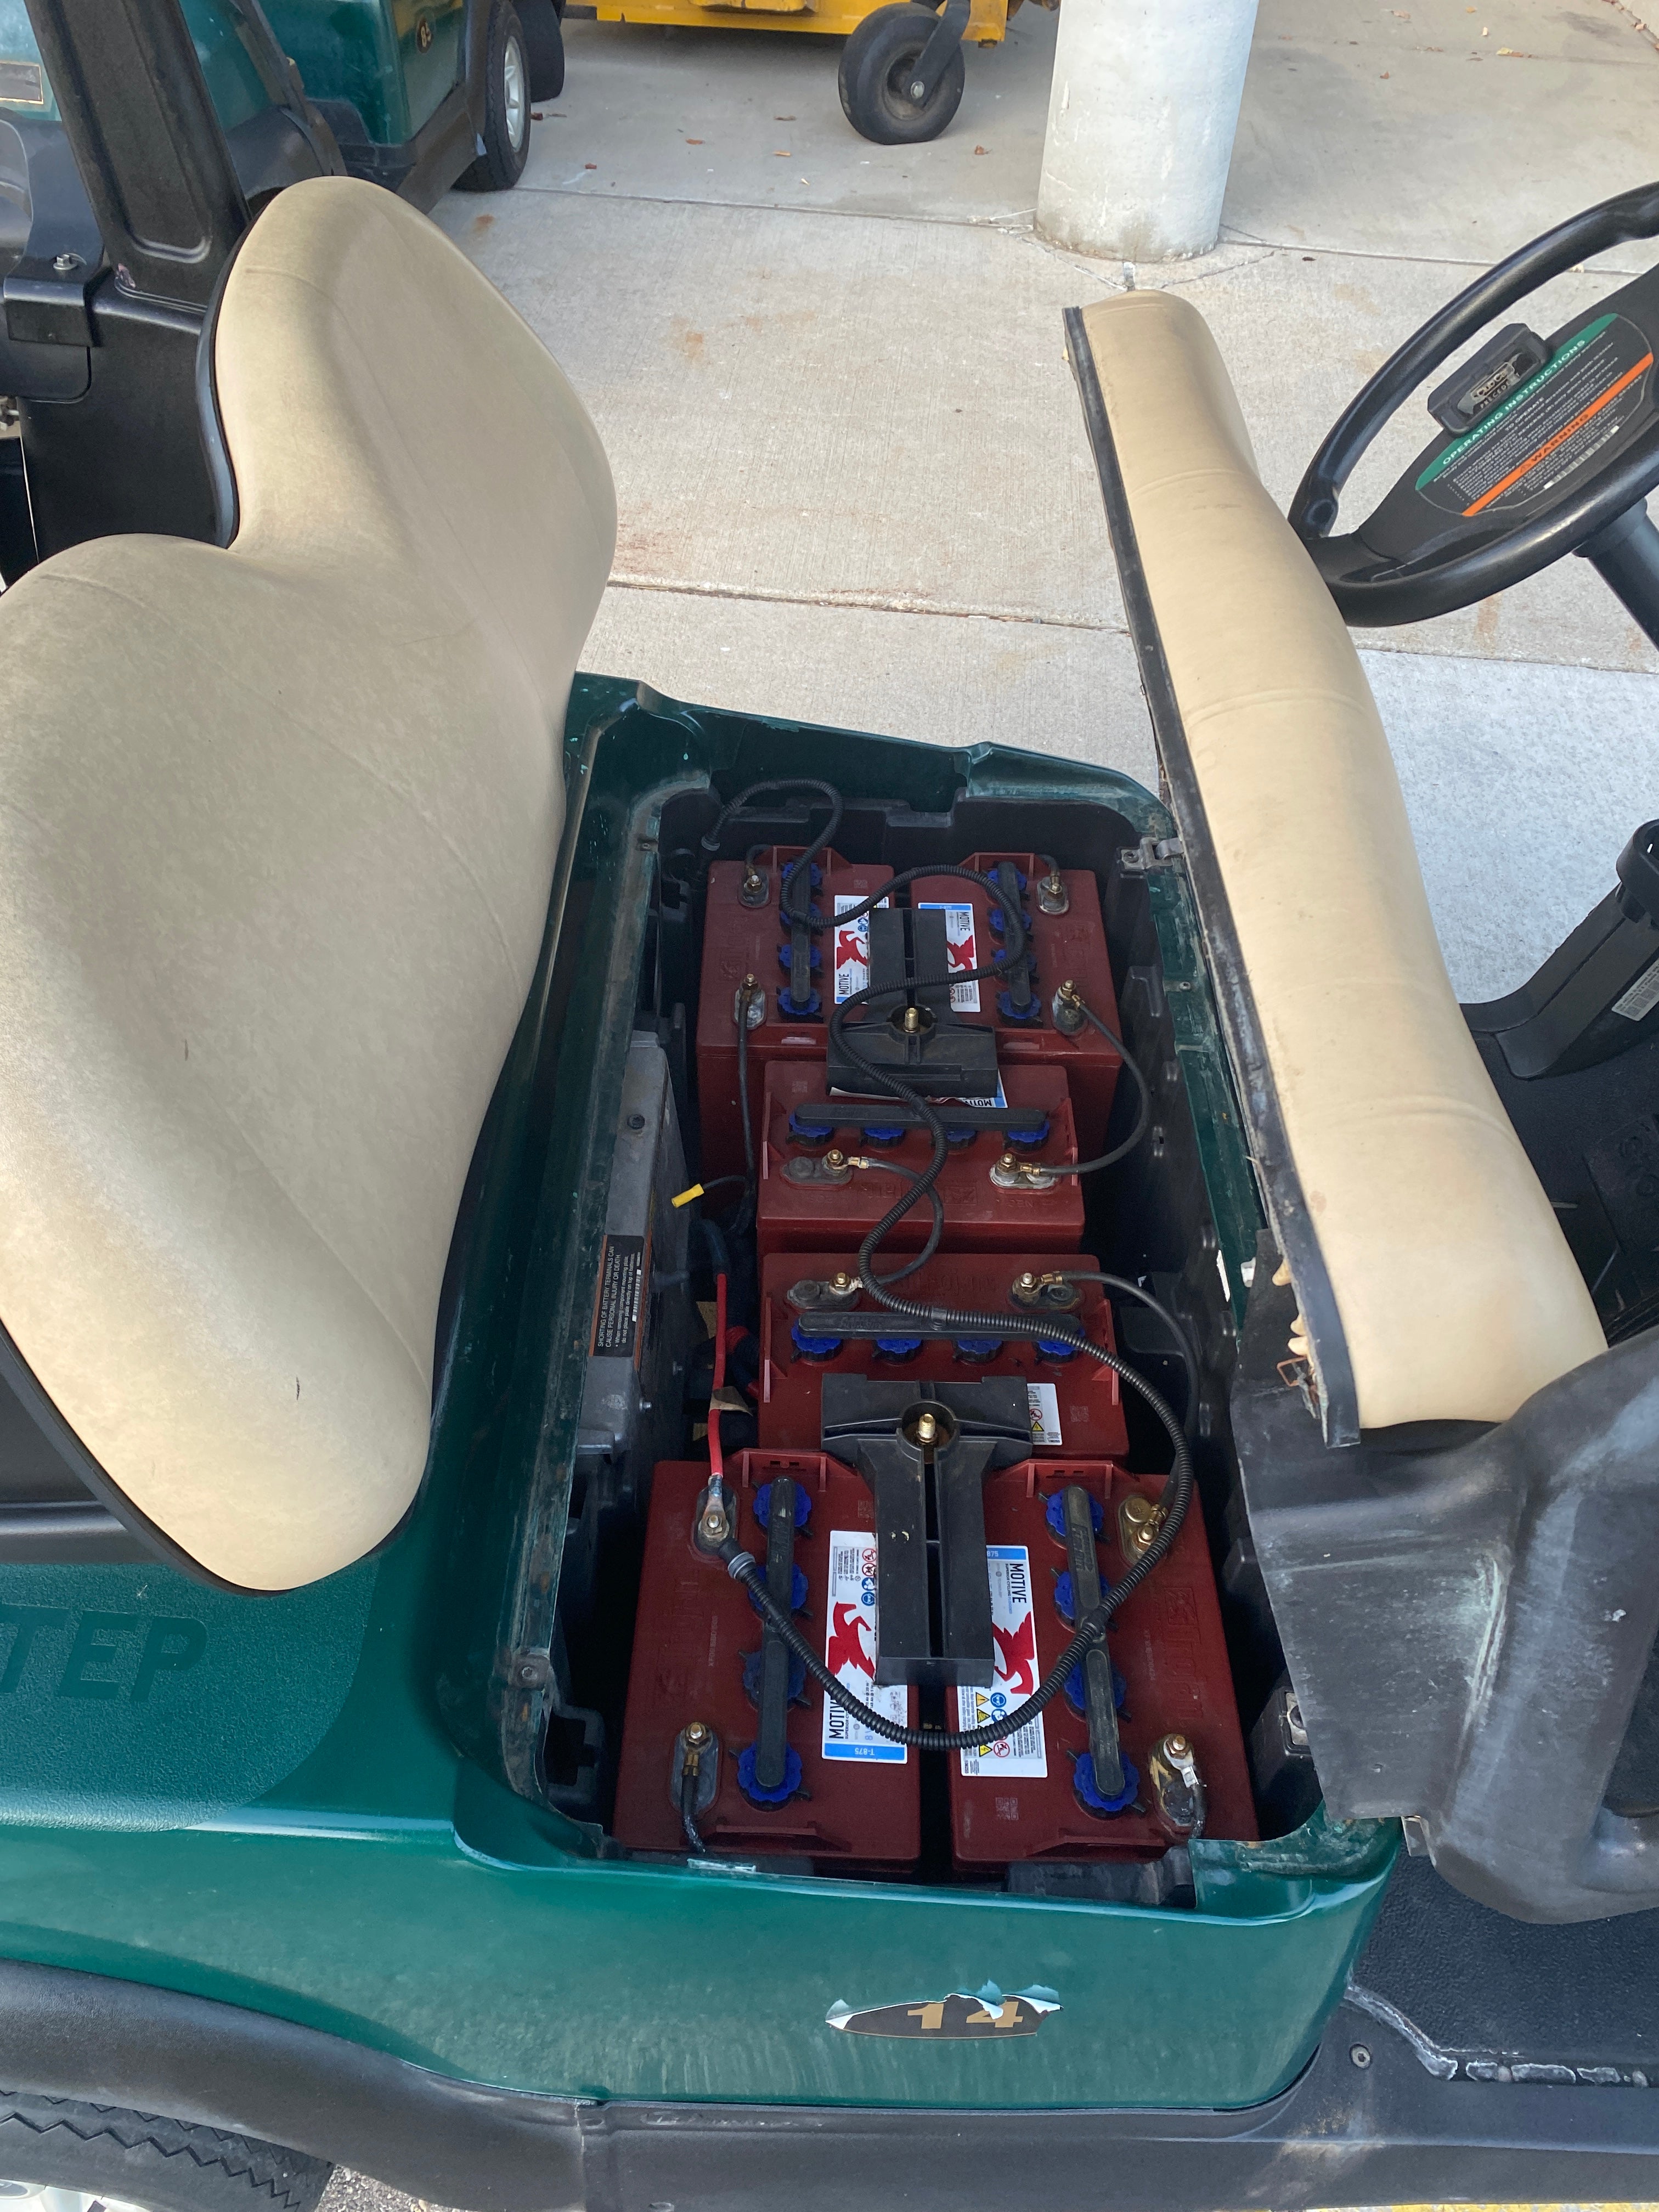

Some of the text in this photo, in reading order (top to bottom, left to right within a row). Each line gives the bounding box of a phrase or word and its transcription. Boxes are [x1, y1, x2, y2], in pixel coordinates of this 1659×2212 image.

[1441, 337, 1586, 466] OPERATING INSTRUCTIONS
[1530, 412, 1589, 463] WARNING
[958, 911, 970, 931] MOTIVE
[838, 973, 849, 995] MOTIVE
[605, 1257, 613, 1286] TERMINALS
[602, 1286, 610, 1310] BATTERY
[607, 1299, 616, 1328] PERSONAL
[612, 1271, 619, 1280] OR
[597, 1318, 606, 1347] SHORTING
[1008, 1562, 1028, 1605] MOTIVE
[854, 1747, 875, 1756] T-875
[907, 2001, 1024, 2029] 14
